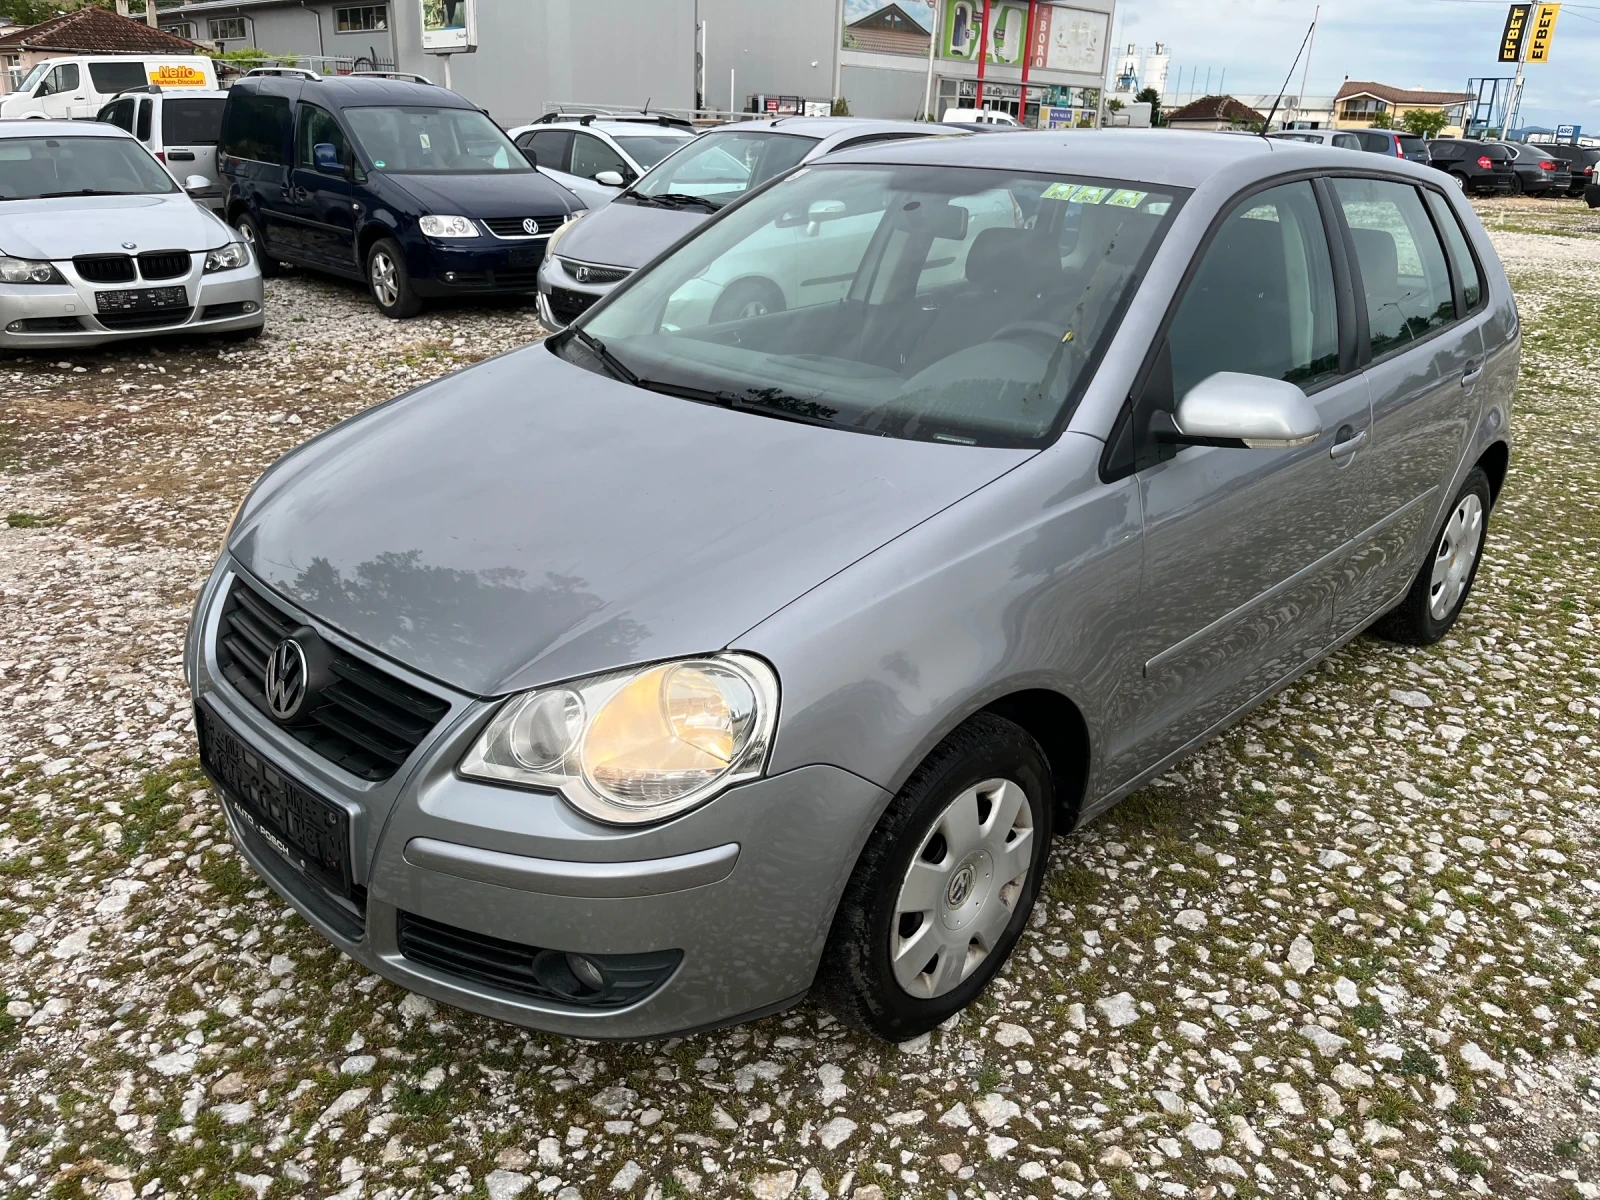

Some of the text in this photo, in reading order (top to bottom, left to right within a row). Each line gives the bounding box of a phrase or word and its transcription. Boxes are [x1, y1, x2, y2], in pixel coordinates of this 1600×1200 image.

[1504, 8, 1524, 58] EFBET
[1532, 8, 1553, 58] EFBET
[159, 66, 195, 78] Netto
[234, 802, 254, 825] AUTO
